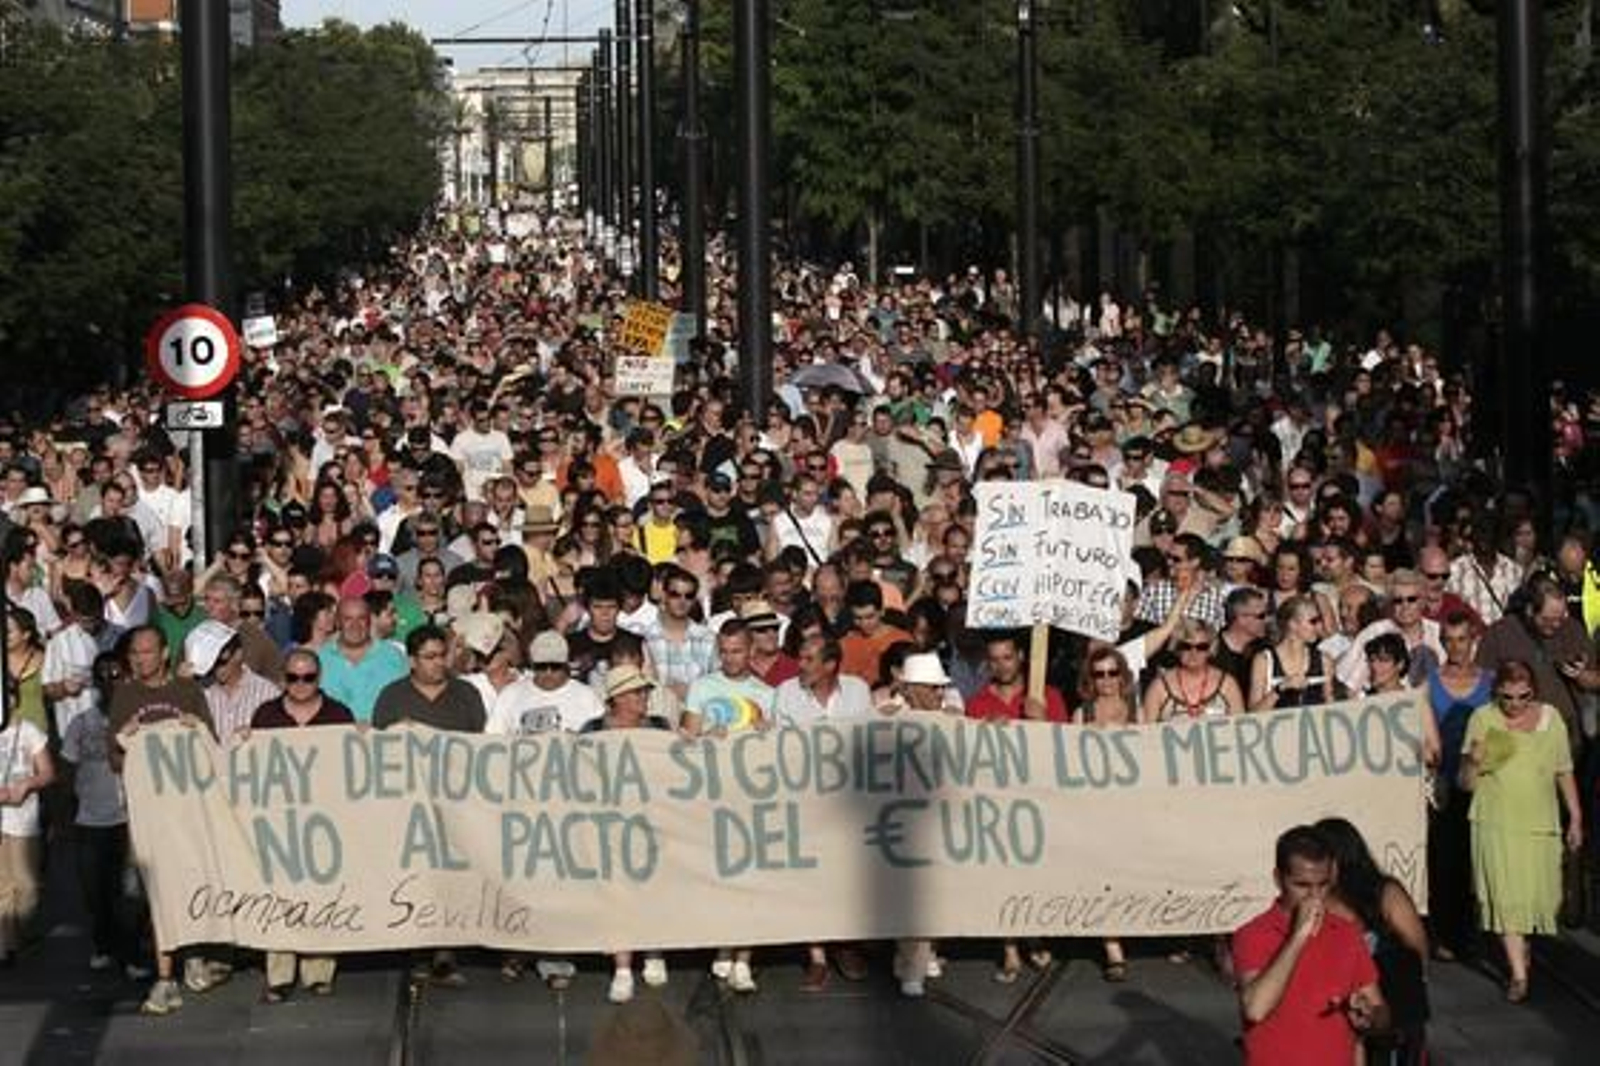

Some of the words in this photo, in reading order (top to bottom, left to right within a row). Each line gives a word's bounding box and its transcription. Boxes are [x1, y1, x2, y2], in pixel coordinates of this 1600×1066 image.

[169, 336, 214, 366] 10
[1041, 490, 1130, 529] TRABAJO
[1034, 530, 1119, 569] FUTURO
[145, 731, 214, 795] NO
[228, 736, 318, 808] HAY
[343, 730, 649, 806] DEMOCRACIA
[668, 736, 722, 800] SI
[731, 719, 1029, 801] GOBIERNAN
[1053, 722, 1139, 788] LOS
[1163, 698, 1423, 787] MERCADOS
[253, 808, 342, 884] NO
[401, 803, 470, 870] AL
[501, 808, 660, 882] PACTO
[713, 803, 817, 877] DEL
[387, 874, 530, 935] Sevilla
